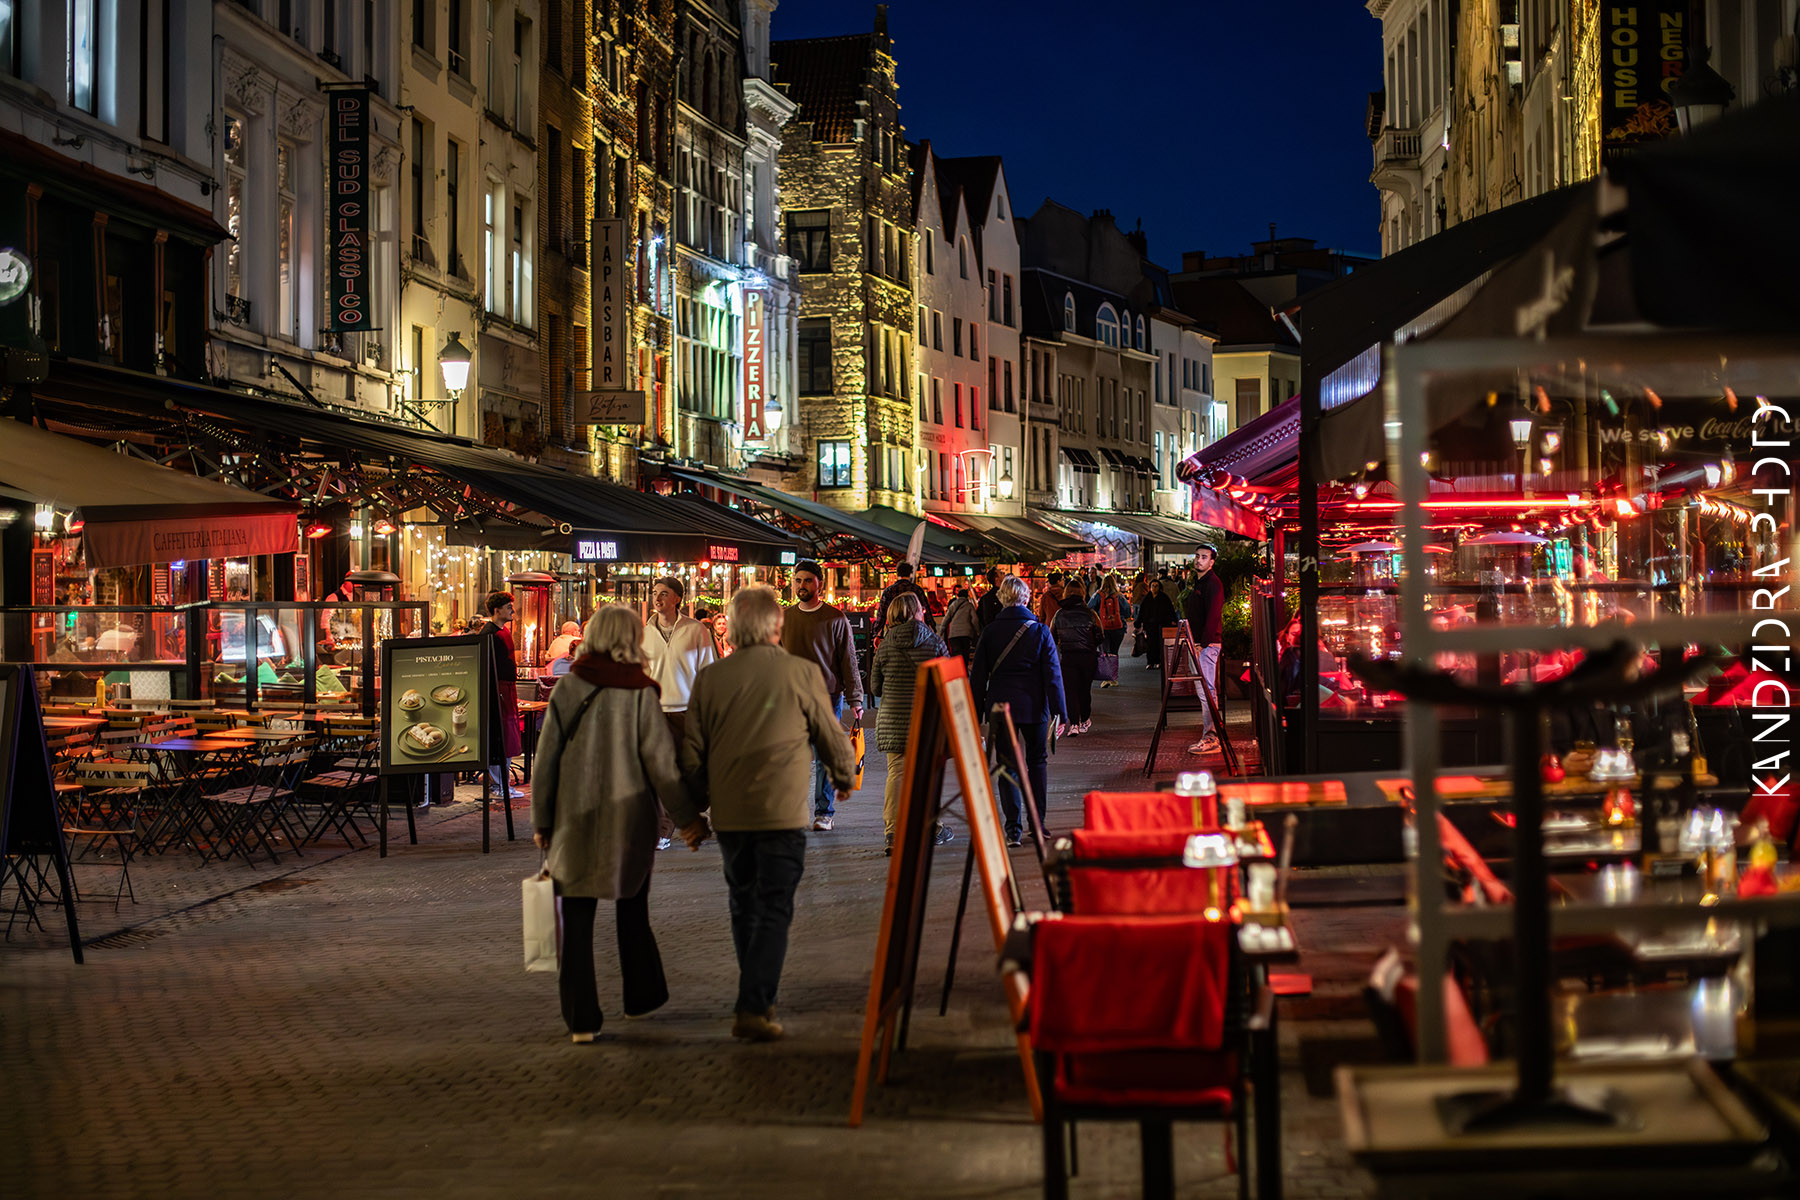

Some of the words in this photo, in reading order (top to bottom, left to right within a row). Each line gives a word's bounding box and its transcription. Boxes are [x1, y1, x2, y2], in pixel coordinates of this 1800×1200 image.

[1611, 7, 1639, 108] HOUSE
[338, 98, 360, 142] DEL
[338, 150, 361, 195] SUD
[338, 202, 363, 323] CLASSICO
[748, 291, 761, 437] PIZZERIA
[1601, 428, 1632, 443] We
[1639, 425, 1695, 442] serve
[578, 541, 596, 559] PIZZA
[601, 541, 617, 559] PASTA
[415, 655, 454, 663] PISTACHIO
